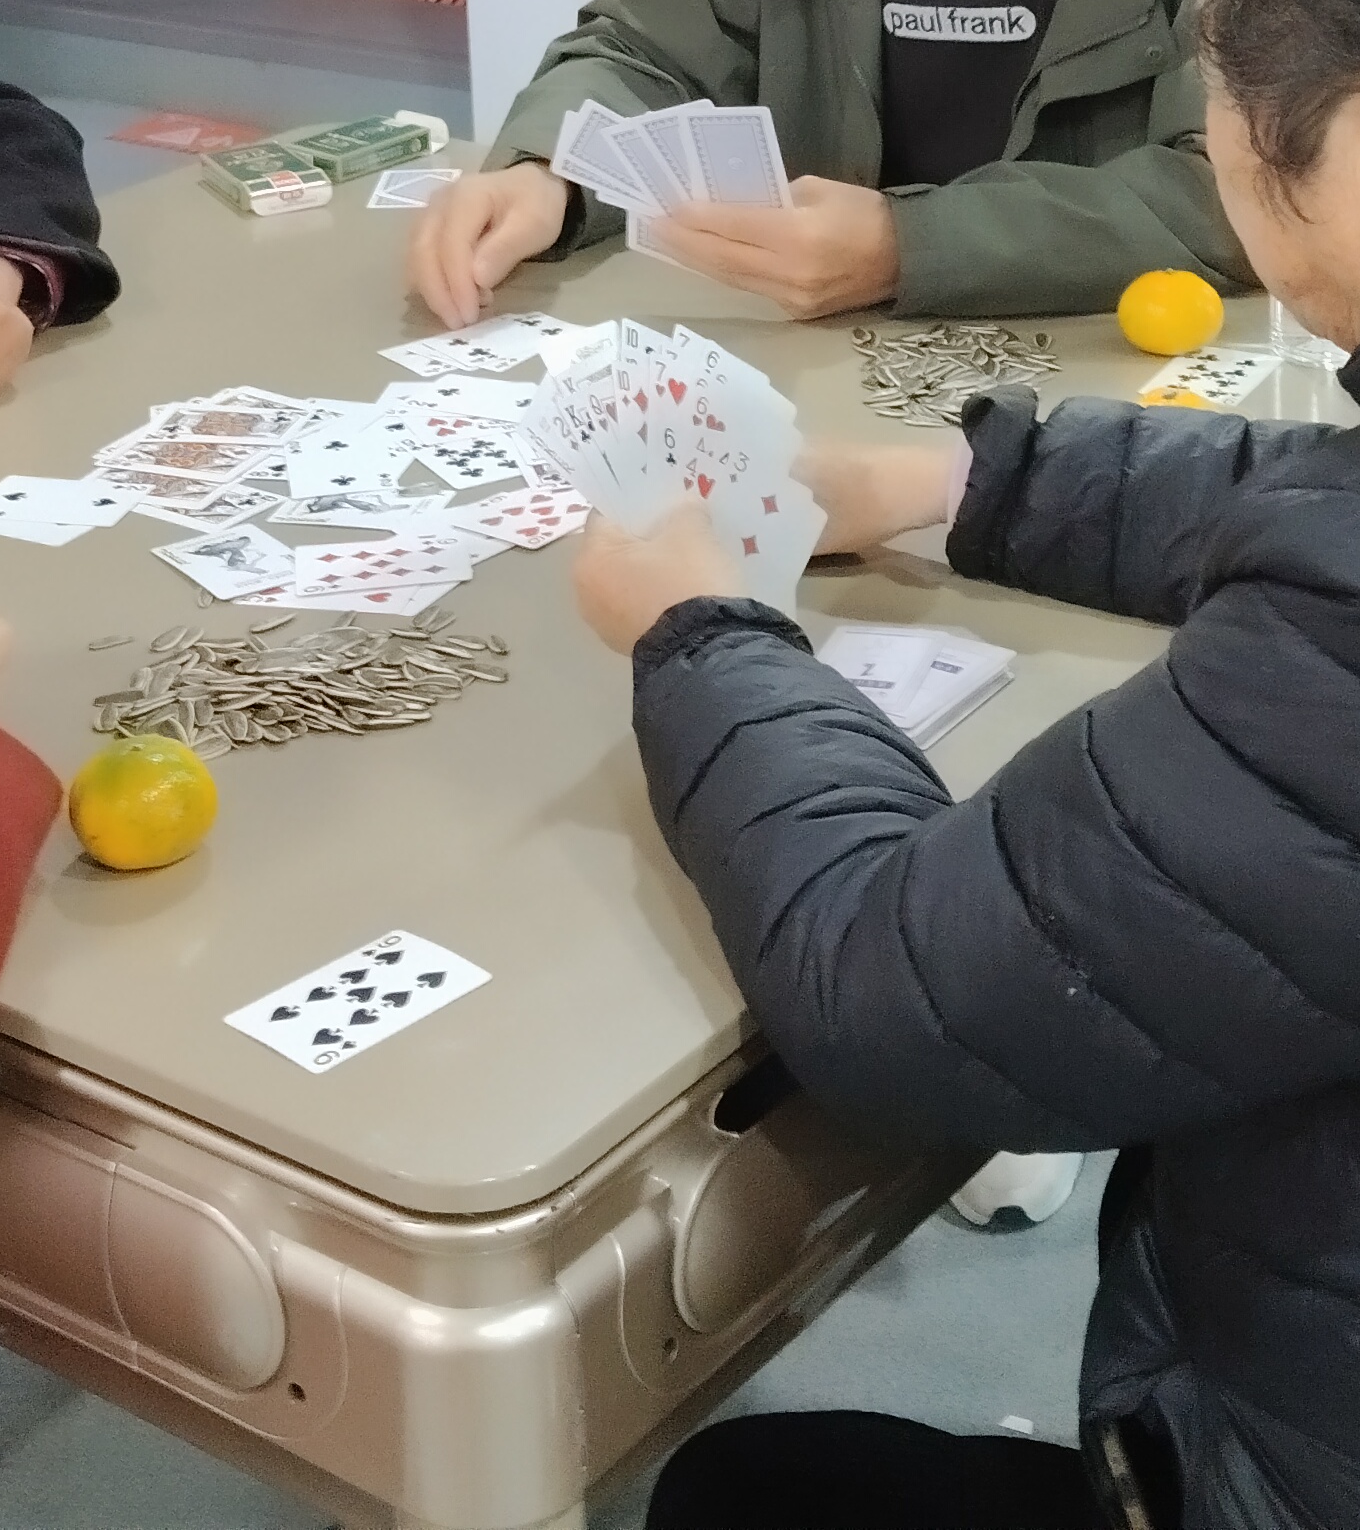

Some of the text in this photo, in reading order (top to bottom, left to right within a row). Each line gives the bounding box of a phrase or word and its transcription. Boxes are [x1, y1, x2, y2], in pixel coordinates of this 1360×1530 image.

[890, 6, 1026, 35] paul frank
[706, 350, 720, 368] 6
[566, 405, 584, 428] K
[696, 396, 709, 415] 6
[553, 416, 571, 439] 2
[664, 427, 676, 449] 6
[734, 452, 750, 473] 3
